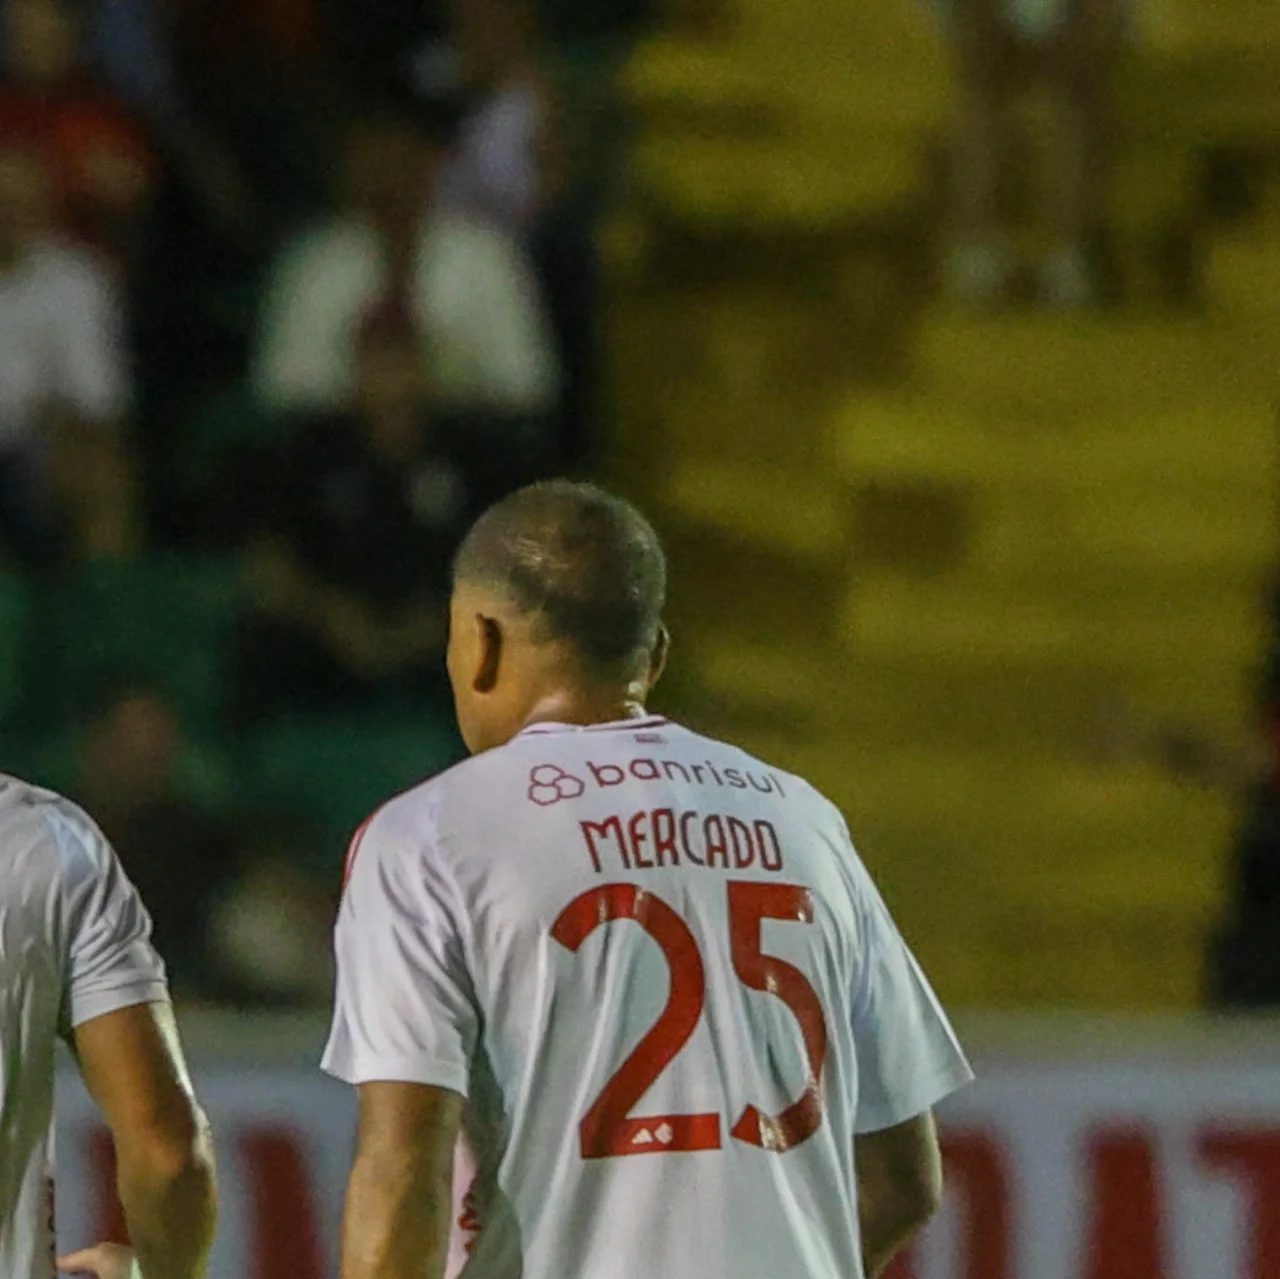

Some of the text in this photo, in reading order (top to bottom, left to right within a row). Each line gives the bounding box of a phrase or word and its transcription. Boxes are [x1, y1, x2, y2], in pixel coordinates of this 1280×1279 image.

[587, 757, 784, 798] banrisul
[580, 808, 783, 872] MERCADO
[549, 880, 828, 1160] 25
